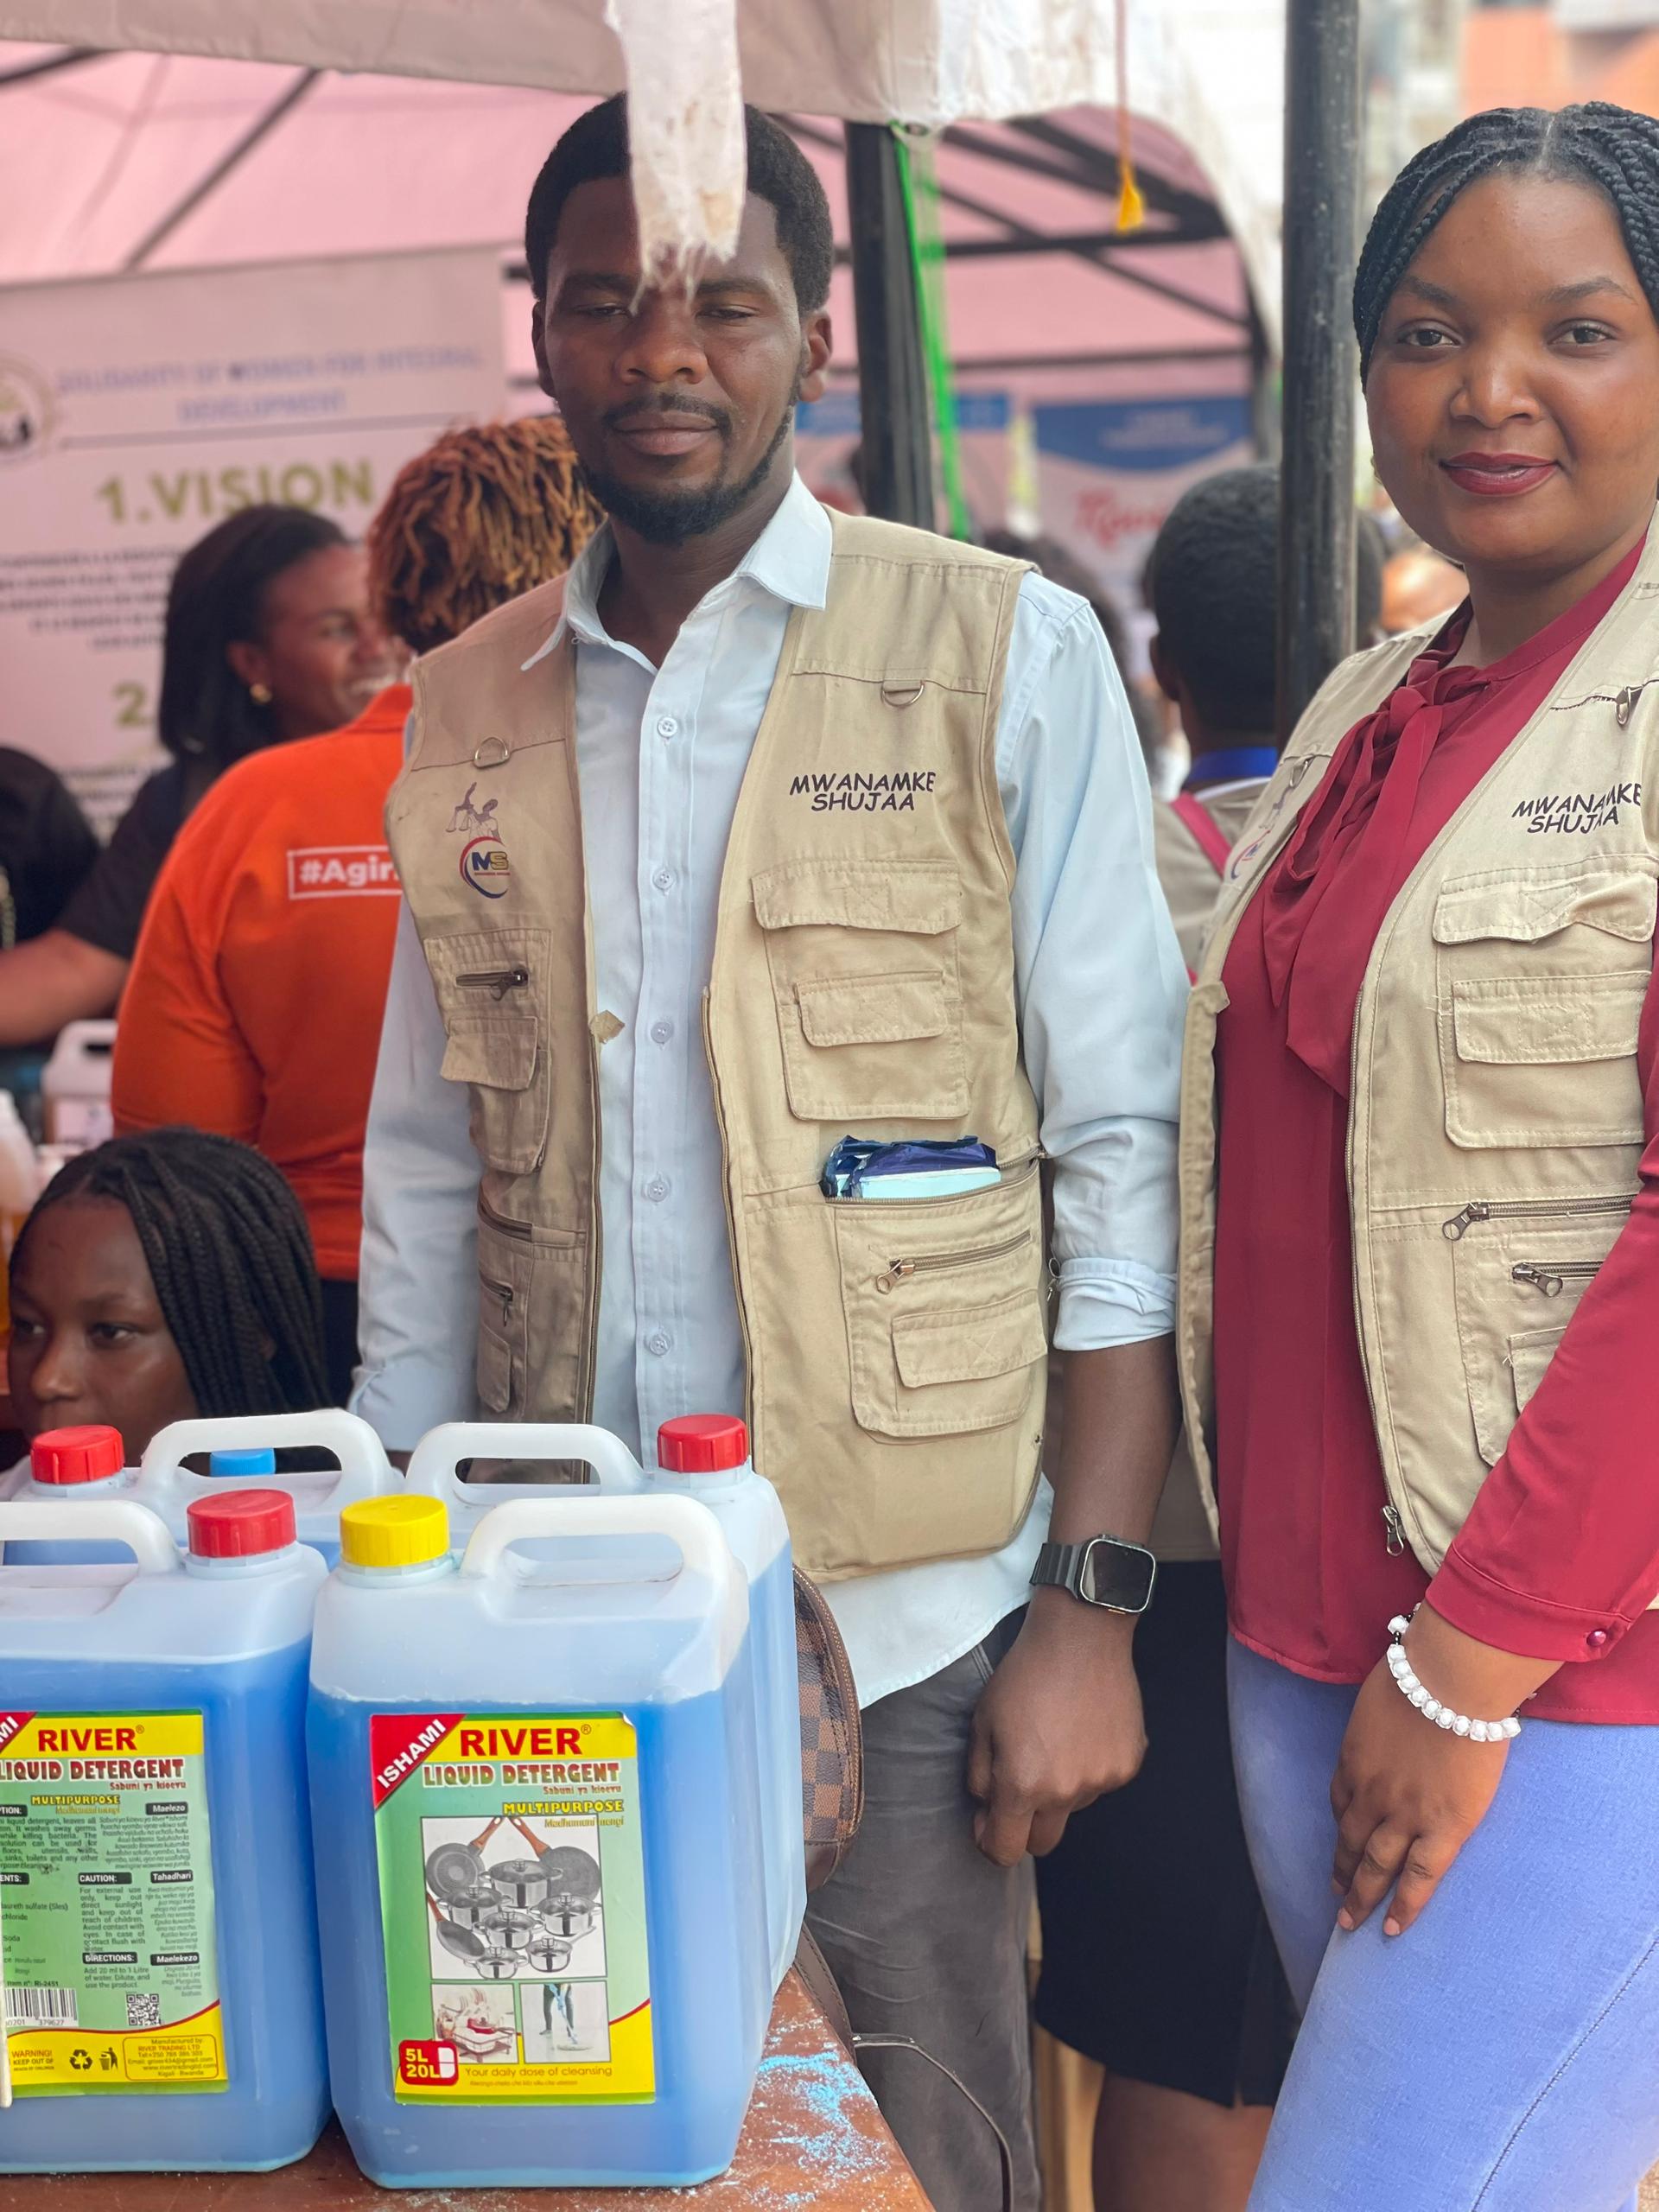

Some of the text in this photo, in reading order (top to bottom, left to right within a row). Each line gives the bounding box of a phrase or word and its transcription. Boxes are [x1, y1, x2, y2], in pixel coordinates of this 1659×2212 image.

[790, 772, 936, 795] MWANAMKE
[811, 792, 914, 811] SHUJAA
[1527, 805, 1619, 834] SHUJAA
[300, 852, 399, 885] #Agir
[376, 1718, 447, 1789] ISHAMI
[71, 1758, 184, 1779] DETERGENT
[423, 1762, 620, 1786] LIQUID DETERGENT
[31, 1795, 120, 1805] MULTIPURPOSE
[543, 1786, 574, 1795] Sabuni
[503, 1800, 624, 1815] MULTIPURPOSE
[405, 2048, 429, 2063] 5L
[407, 2064, 441, 2078] 20L
[465, 2066, 613, 2078] Your daily dose of cleansing
